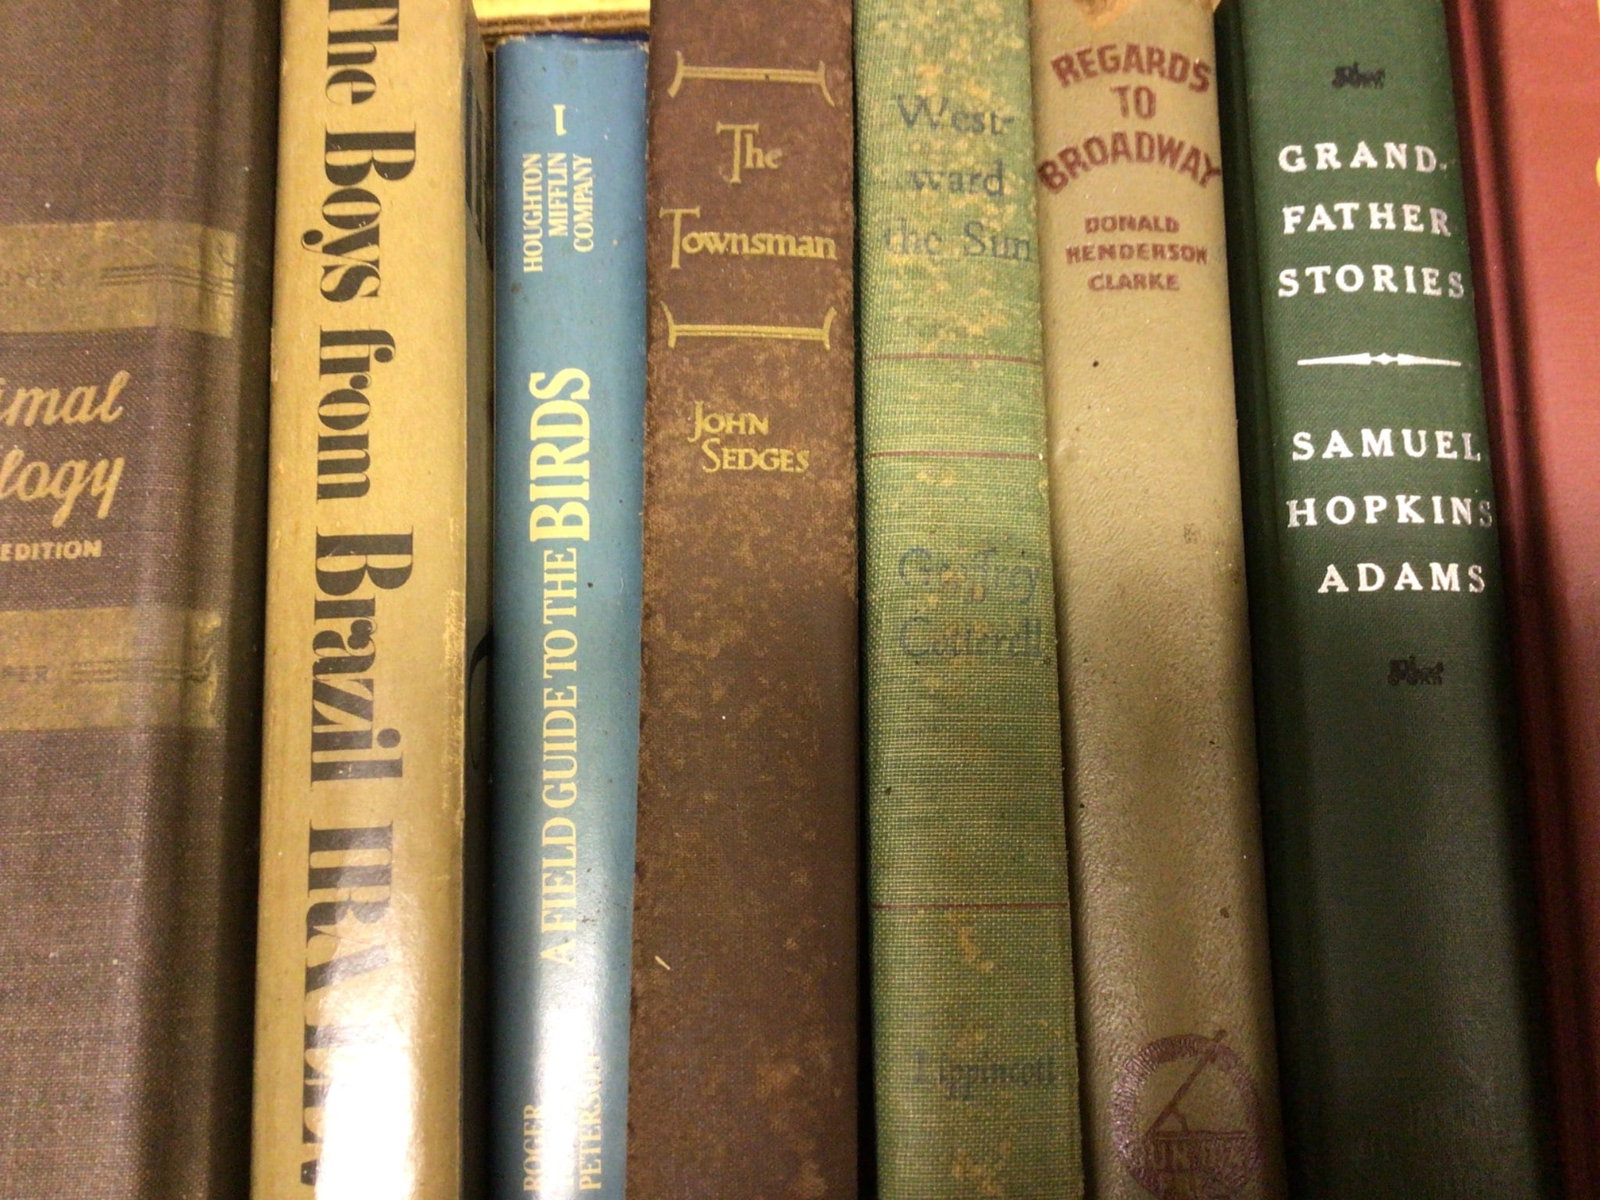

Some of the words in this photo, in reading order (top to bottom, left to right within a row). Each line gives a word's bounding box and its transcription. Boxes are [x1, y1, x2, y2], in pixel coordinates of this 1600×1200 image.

[1051, 43, 1212, 94] REGARDS
[1110, 84, 1157, 120] TO
[716, 122, 783, 184] The
[908, 159, 1006, 197] ward
[1036, 131, 1221, 194] BROADWAY
[301, 121, 416, 303] Boys
[522, 152, 544, 273] HOUGHTON
[547, 151, 569, 238] MIFFLIN
[572, 152, 595, 253] COMPANY
[1282, 202, 1451, 237] FATHER
[659, 205, 838, 270] Townsman
[963, 220, 1034, 263] Sun
[1084, 215, 1181, 234] DONALD
[1065, 243, 1208, 265] HENDERSON
[1087, 273, 1180, 292] CLARKE
[1277, 264, 1465, 298] STORIES
[316, 325, 396, 504] from
[688, 401, 769, 442] JOHN
[528, 367, 591, 543] BIRDS
[701, 438, 809, 473] SEDGES
[1292, 428, 1481, 462] SAMUEL
[1286, 495, 1493, 528] HOPKINS
[0, 539, 103, 562] EDITION
[543, 547, 577, 625] THE
[1317, 562, 1486, 594] ADAMS
[310, 525, 414, 789] Brazil
[543, 629, 578, 680] TO
[542, 685, 578, 809] GUIDE
[541, 816, 577, 933] FIELD
[305, 819, 394, 1000] IRA
[540, 938, 576, 968] A
[523, 1104, 545, 1192] ROGER
